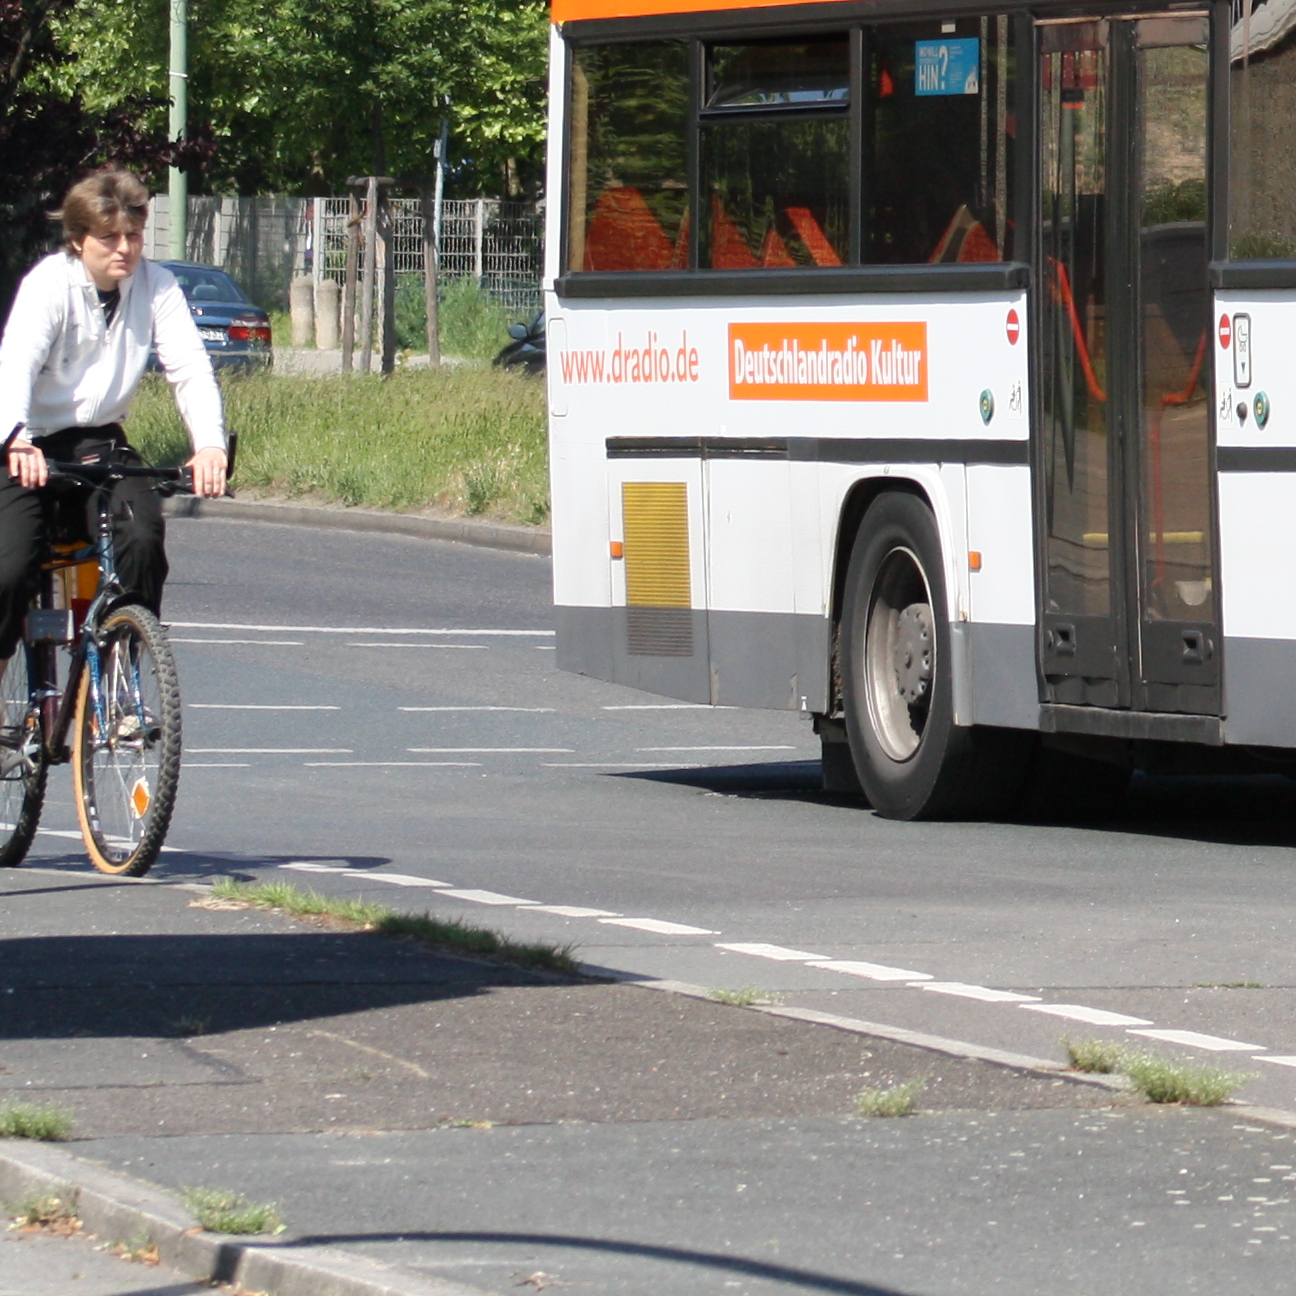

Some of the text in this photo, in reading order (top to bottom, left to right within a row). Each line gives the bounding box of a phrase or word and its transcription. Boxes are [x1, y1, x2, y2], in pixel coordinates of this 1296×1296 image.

[560, 329, 699, 384] www.dradio.de
[734, 334, 921, 386] Deutschlandradio Kultur
